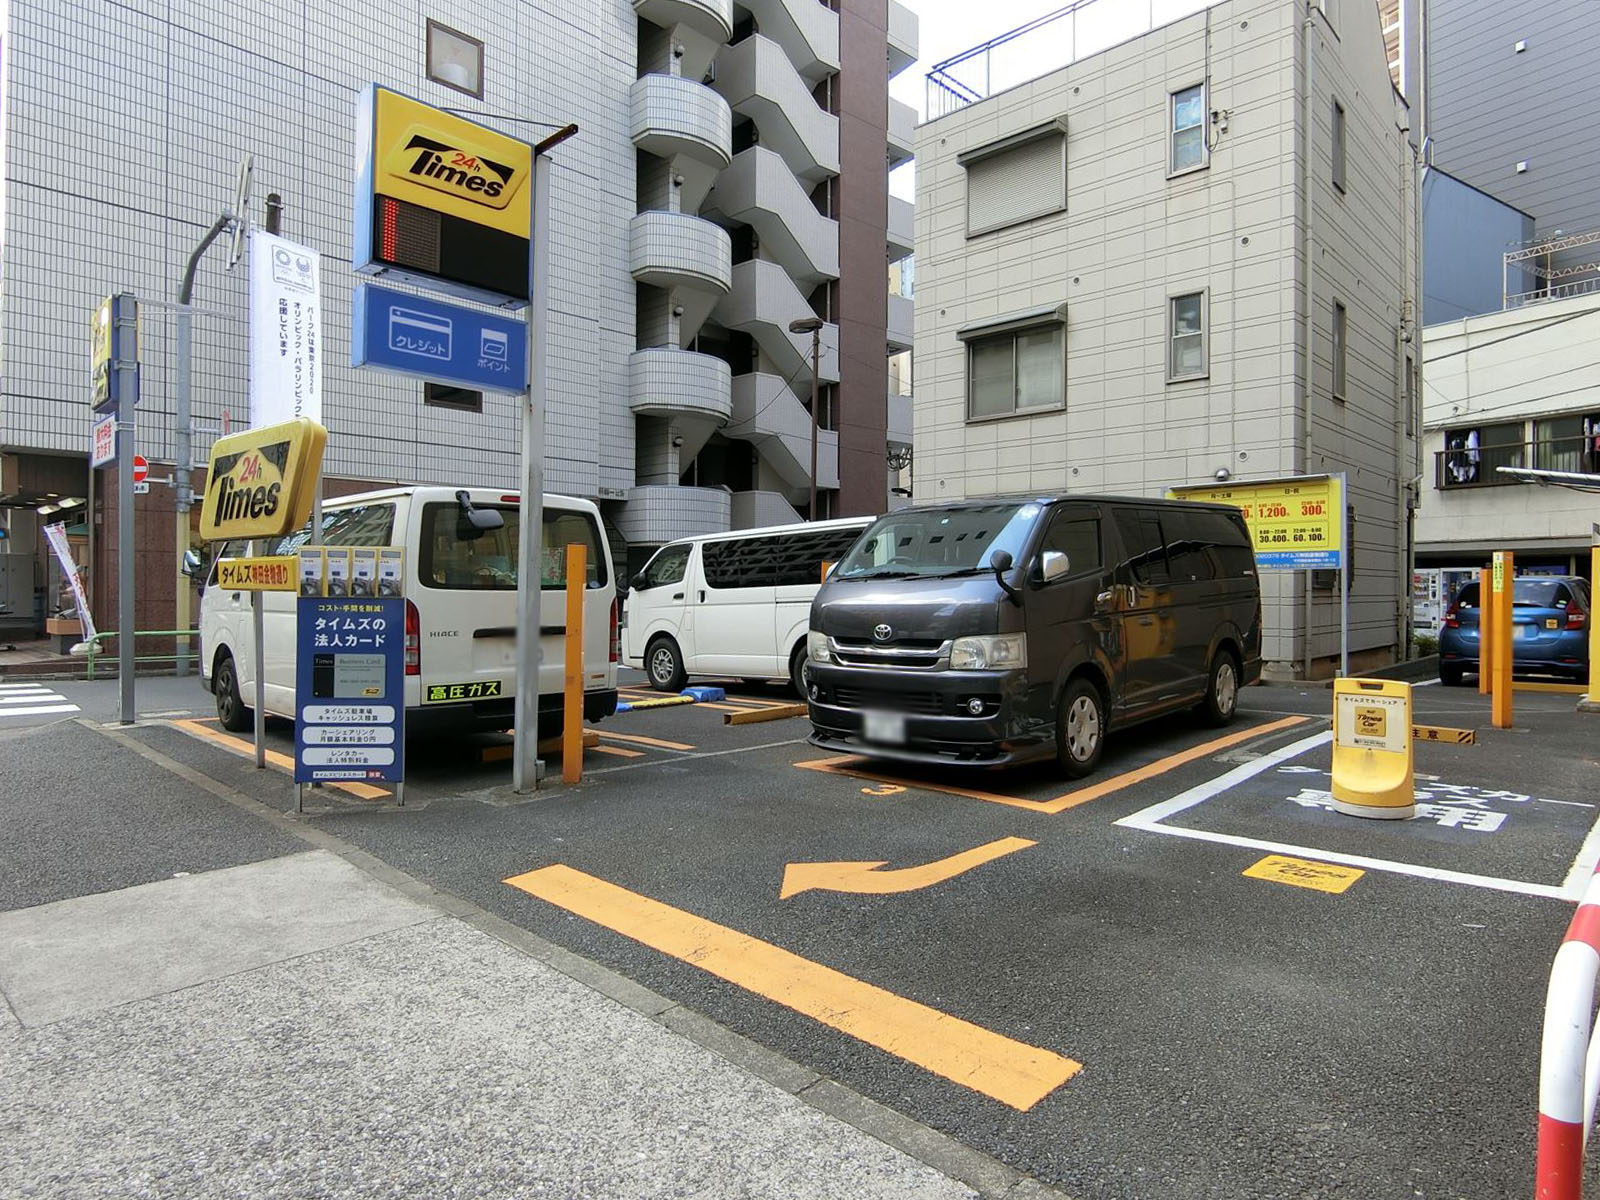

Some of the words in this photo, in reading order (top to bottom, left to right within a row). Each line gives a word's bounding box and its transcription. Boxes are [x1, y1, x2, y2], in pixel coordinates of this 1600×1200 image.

[406, 142, 506, 198] Times
[450, 152, 481, 172] 24h
[279, 298, 289, 357] 応援しています
[395, 335, 446, 355] クレジット
[477, 358, 511, 373] ポイント
[239, 454, 263, 484] 24h
[212, 466, 283, 528] Times
[314, 617, 386, 630] タイムズの
[314, 633, 386, 647] 法人カード
[429, 630, 460, 638] HIACE
[429, 682, 499, 700] 高圧ガス
[1357, 713, 1383, 722] Times
